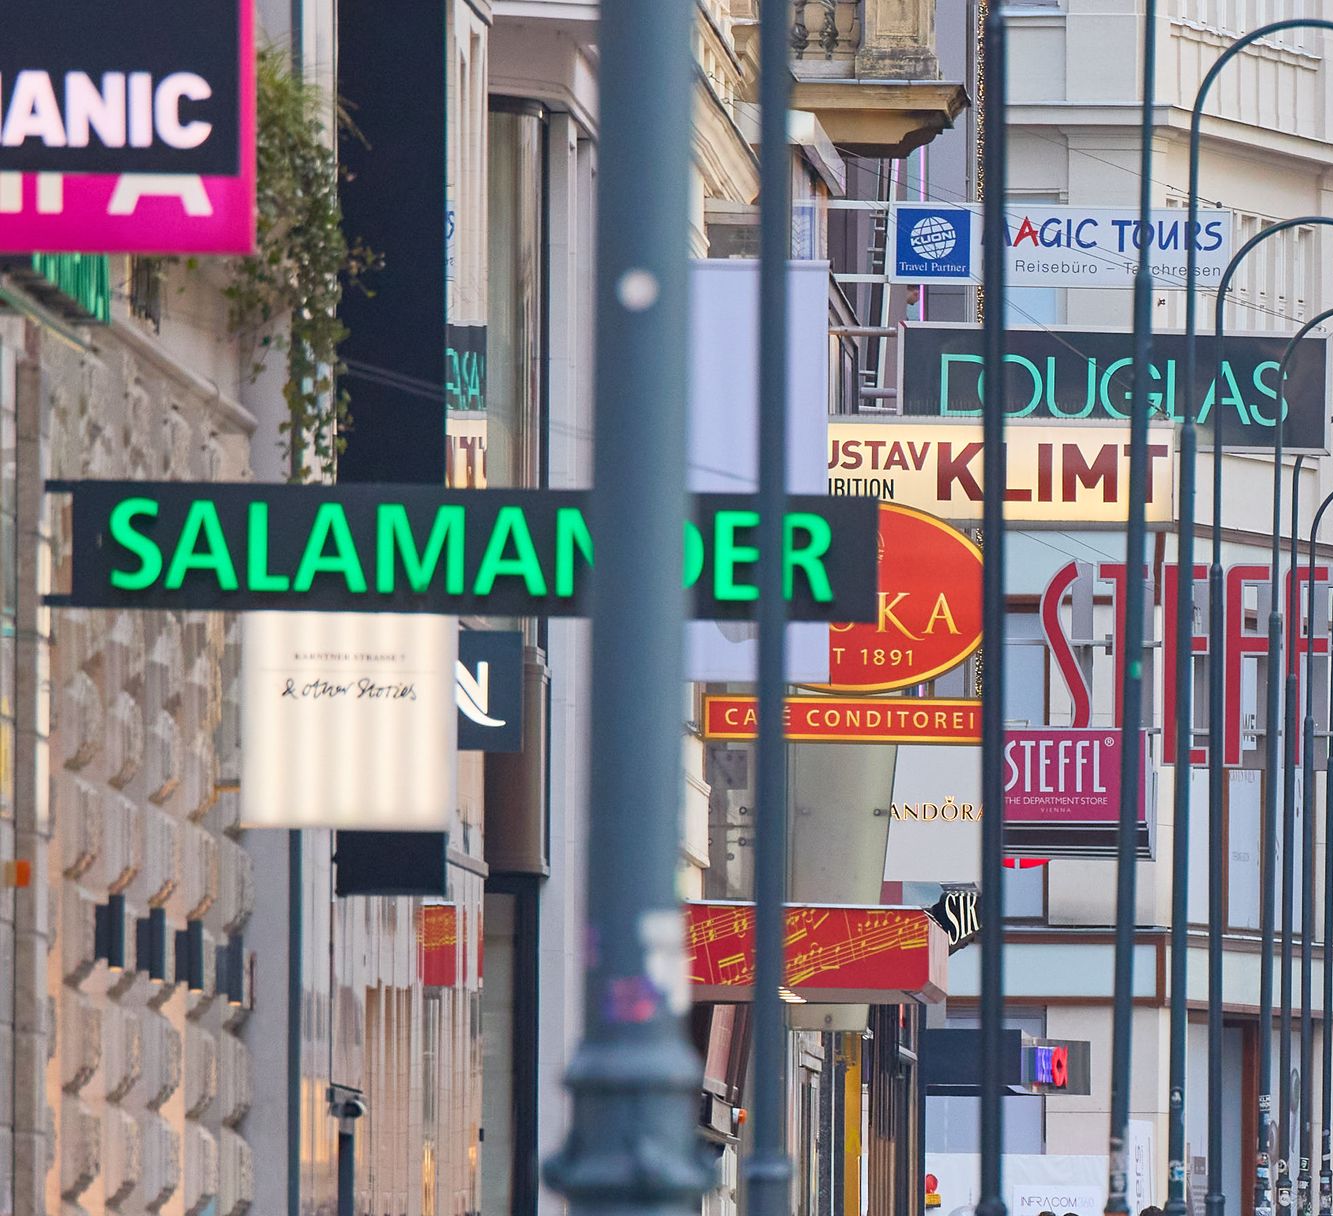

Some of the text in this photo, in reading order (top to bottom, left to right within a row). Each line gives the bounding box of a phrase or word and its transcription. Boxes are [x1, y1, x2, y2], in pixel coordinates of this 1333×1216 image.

[0, 70, 213, 150] ANIC
[910, 230, 957, 247] KUONI
[899, 261, 968, 273] Travel Partner
[1015, 259, 1222, 277] Reisebüro Tachresen
[940, 353, 1290, 428] DOUGLAS
[860, 648, 914, 667] 1891
[806, 708, 976, 730] CONDITOREI
[1023, 796, 1079, 806] DEPARTMENT
[1081, 796, 1108, 806] STORE
